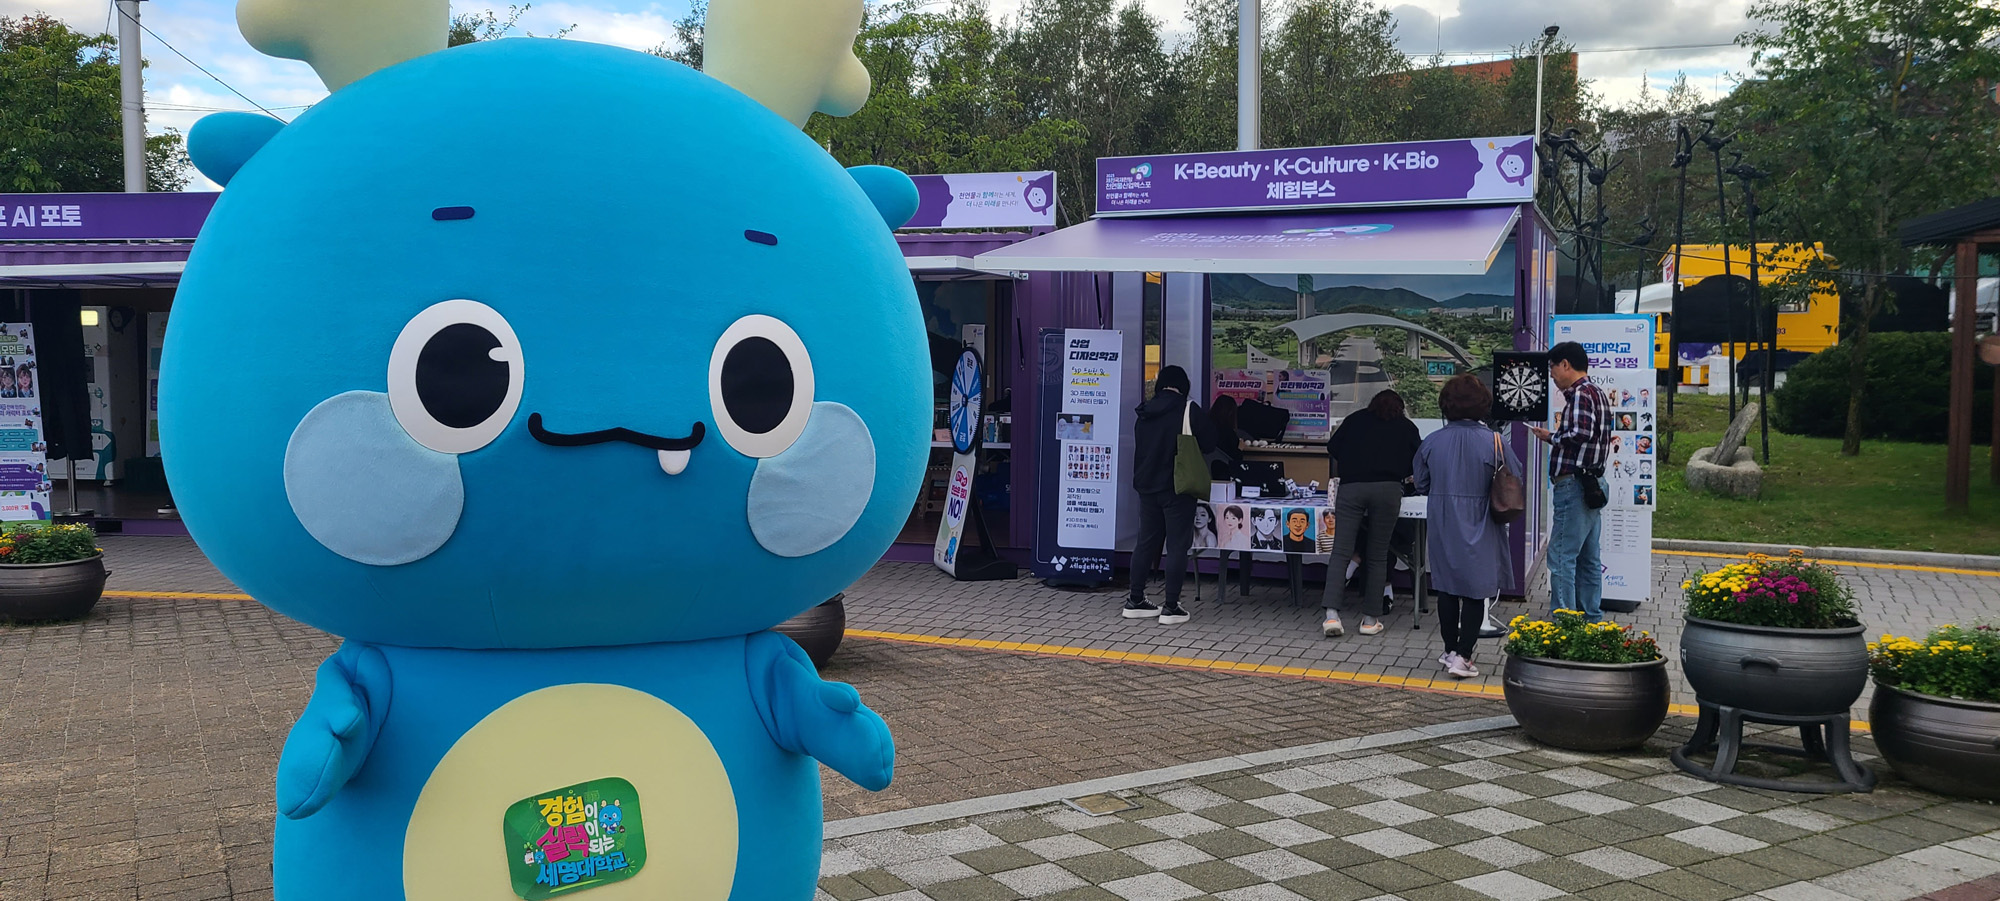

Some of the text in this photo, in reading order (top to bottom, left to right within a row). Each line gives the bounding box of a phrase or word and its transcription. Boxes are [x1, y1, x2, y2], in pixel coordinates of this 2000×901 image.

[1174, 150, 1439, 181] K-Beauty K-Culture K-Bio
[1266, 180, 1336, 199] 체험부스
[11, 205, 36, 227] AI
[41, 205, 82, 227] 포토
[1069, 338, 1090, 349] 산업
[1581, 342, 1631, 354] 명대학교
[1069, 350, 1119, 361] 디자인학과
[1615, 357, 1639, 369] 일정
[1591, 375, 1615, 385] Style
[948, 498, 964, 521] NO!
[1069, 562, 1110, 574] 세명대학교
[537, 795, 598, 827] 경험이
[536, 819, 600, 863] 실력이
[589, 834, 615, 854] 되는
[536, 851, 629, 887] 세명대학교
